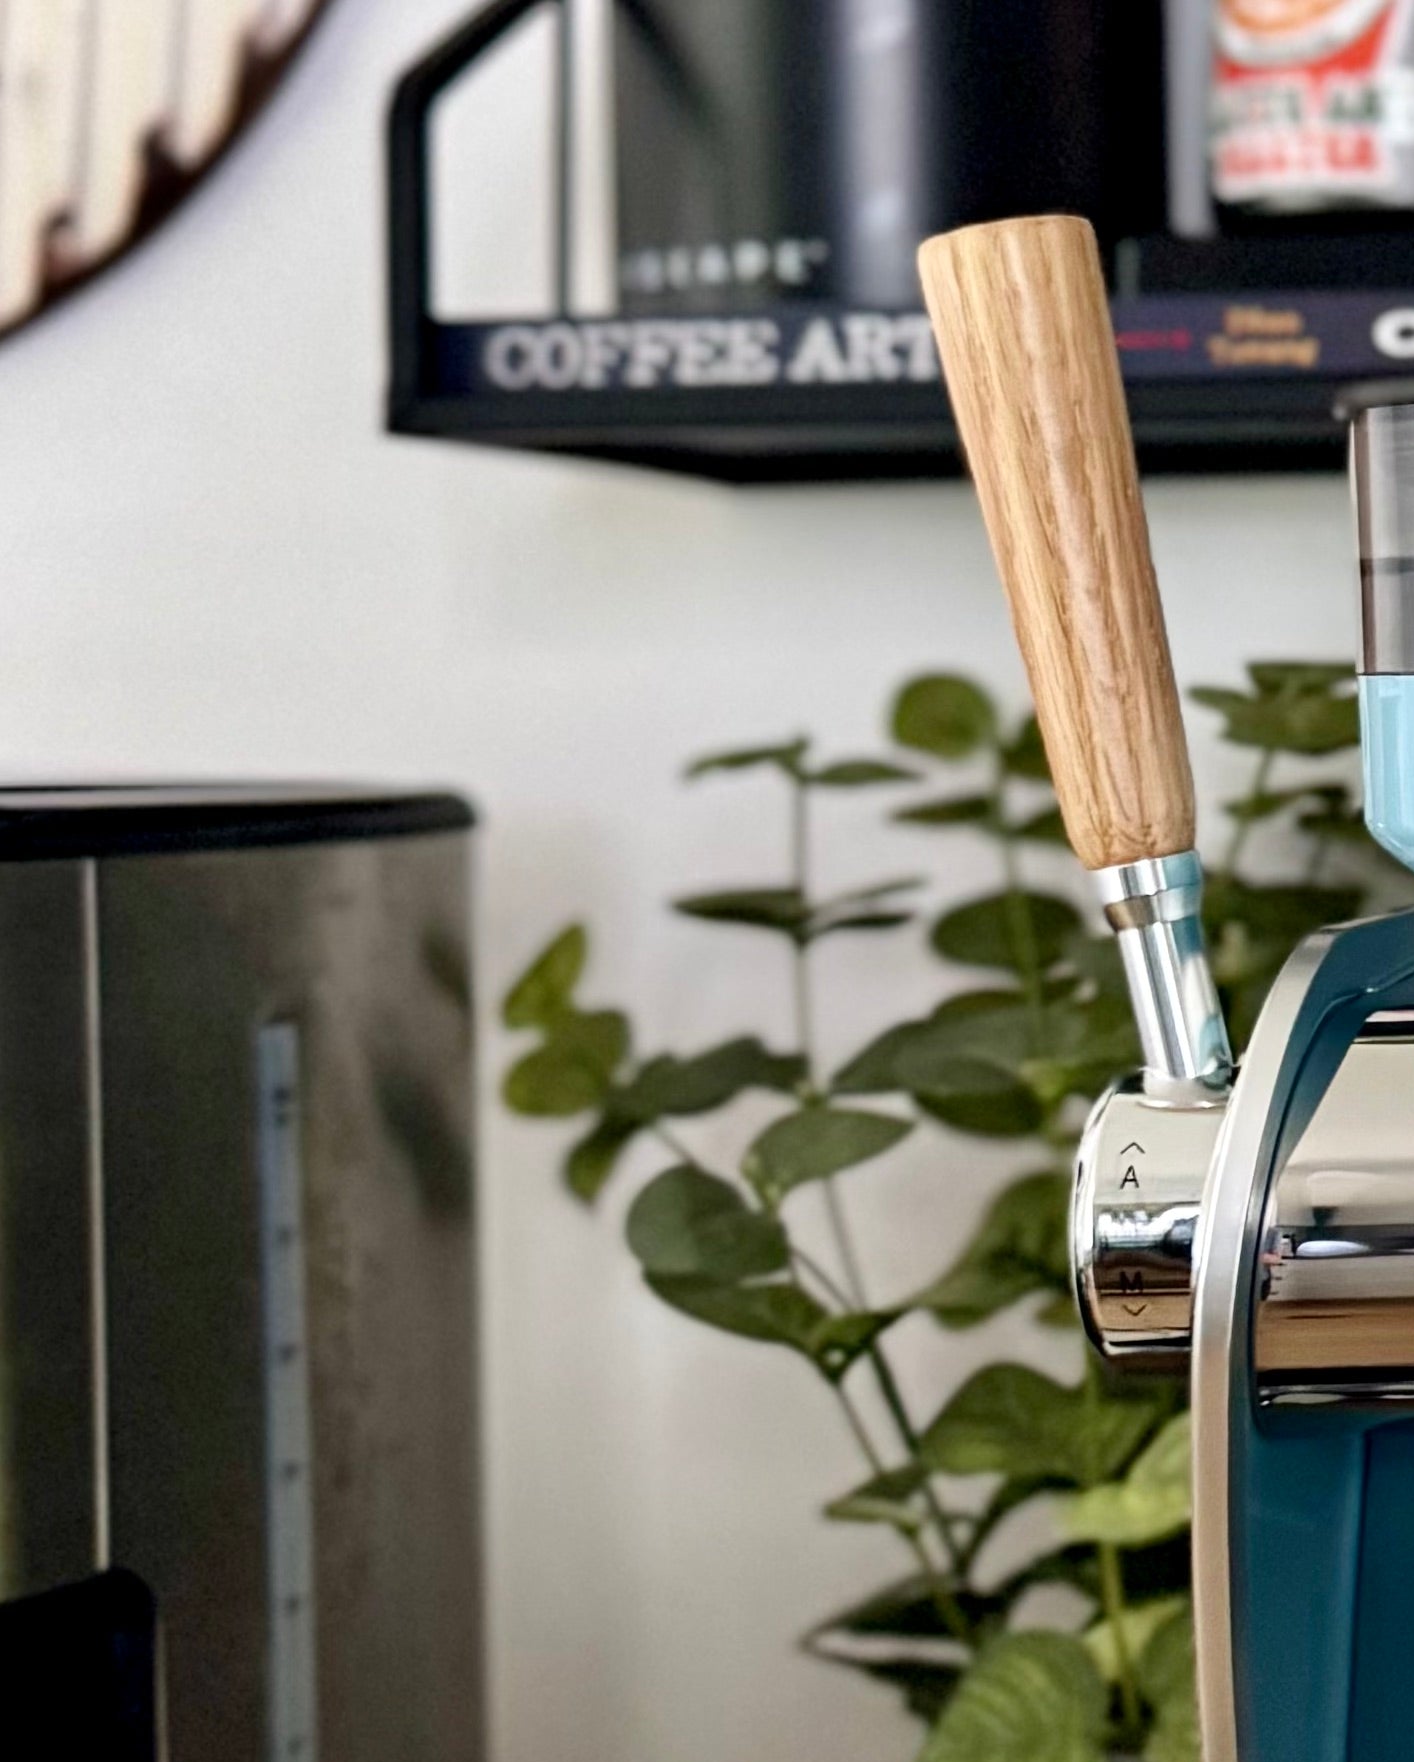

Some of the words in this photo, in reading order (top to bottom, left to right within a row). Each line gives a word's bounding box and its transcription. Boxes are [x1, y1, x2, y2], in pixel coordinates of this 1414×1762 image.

[482, 317, 781, 390] COFFEE
[1120, 1165, 1139, 1189] A
[1119, 1270, 1143, 1293] M
